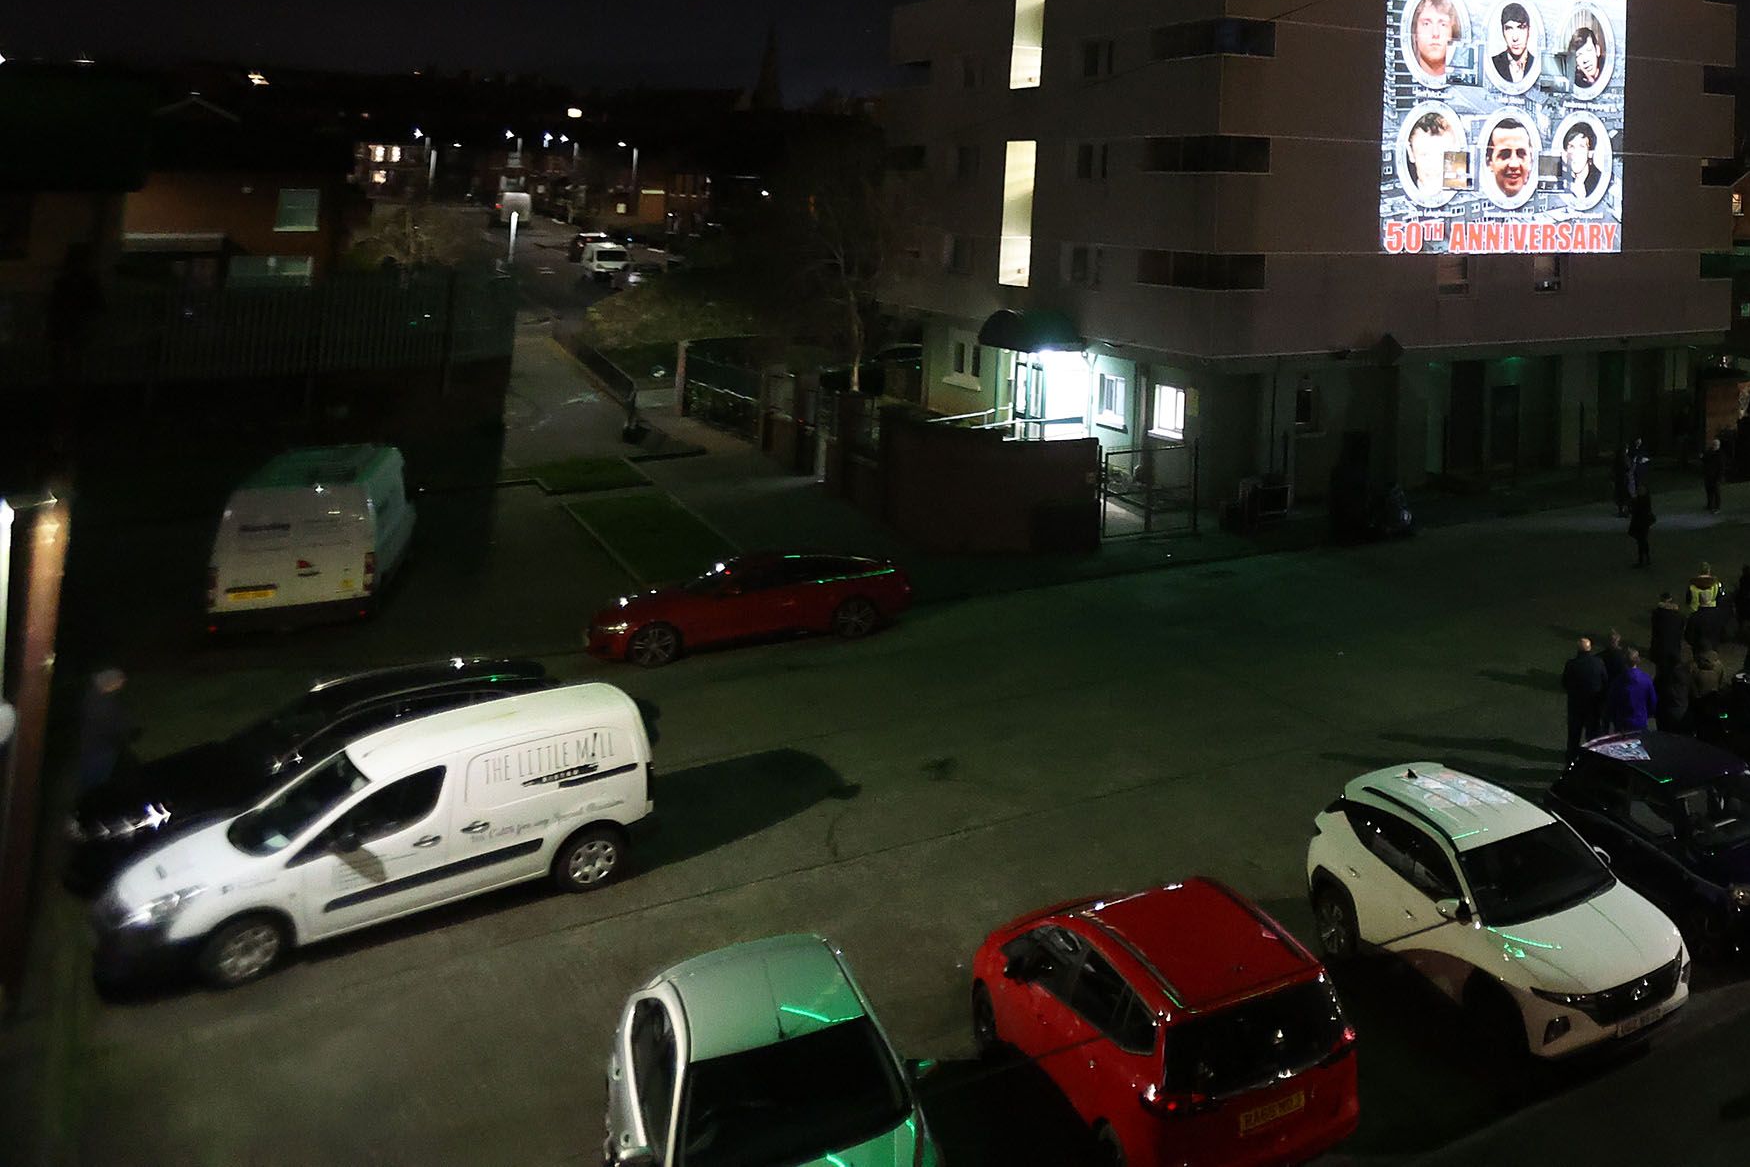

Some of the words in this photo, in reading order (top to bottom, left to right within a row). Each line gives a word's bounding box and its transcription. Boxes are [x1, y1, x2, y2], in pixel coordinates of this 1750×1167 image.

[1385, 222, 1445, 253] 50TH
[1448, 222, 1618, 253] ANNIVERSARY
[484, 754, 512, 785] THE
[518, 741, 570, 778] LITTLE
